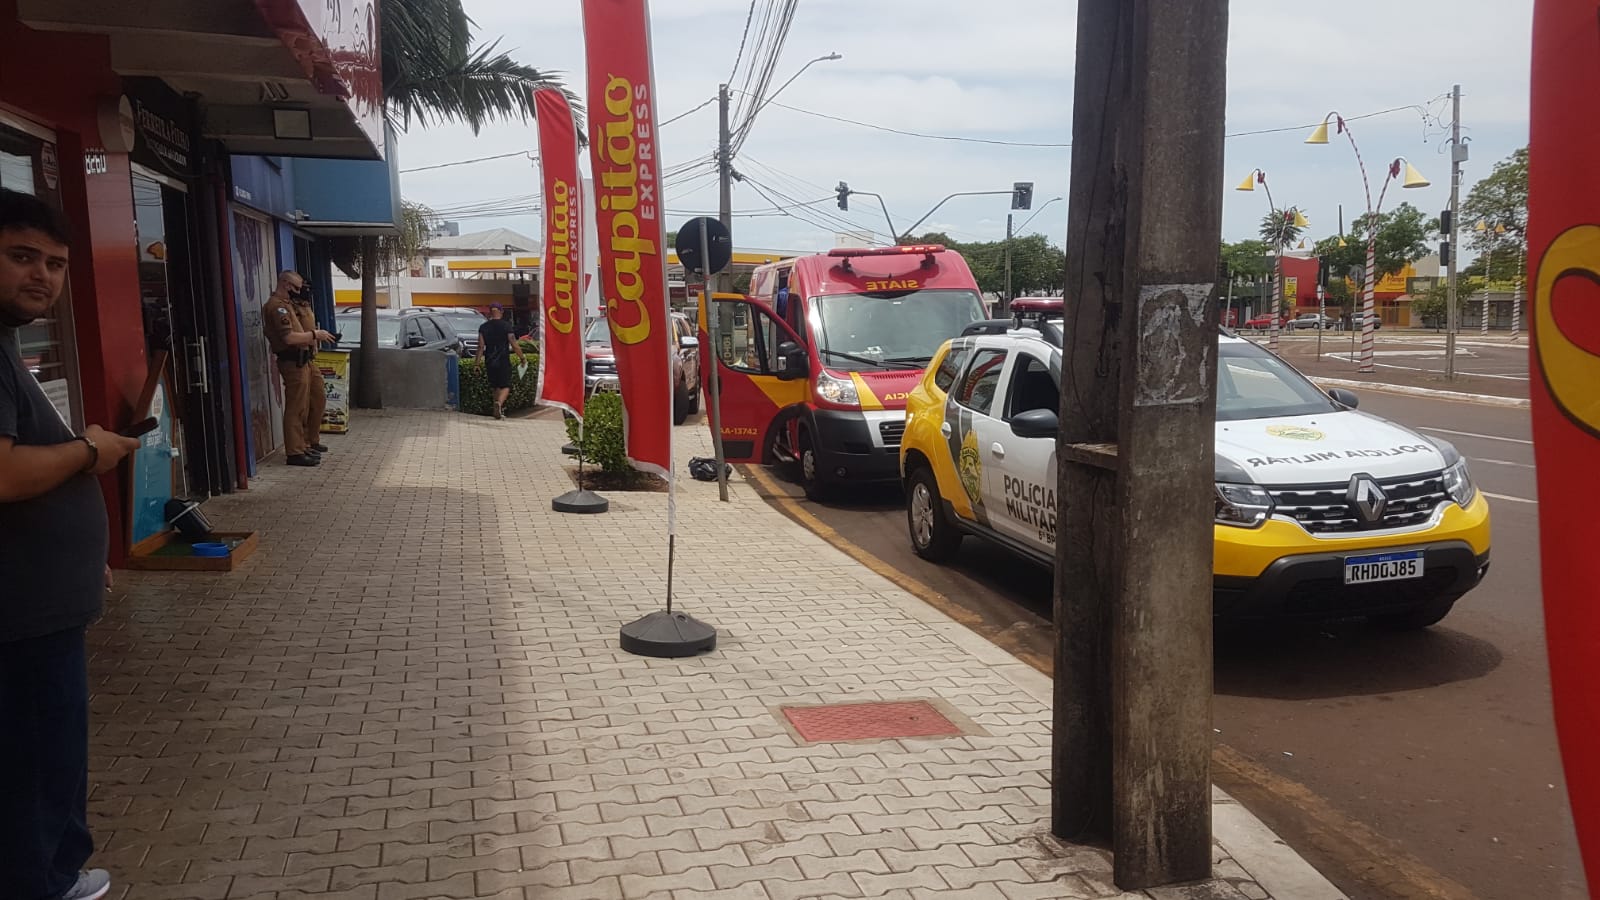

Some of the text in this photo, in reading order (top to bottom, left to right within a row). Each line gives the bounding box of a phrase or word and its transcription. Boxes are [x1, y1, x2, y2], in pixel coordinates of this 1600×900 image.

[635, 83, 655, 221] EXPRESS
[548, 177, 578, 335] Capitão
[569, 186, 578, 263] EXPRESS
[597, 73, 656, 345] Capitão
[1003, 475, 1057, 512] POLÍCIA
[1006, 497, 1057, 534] MILITAR
